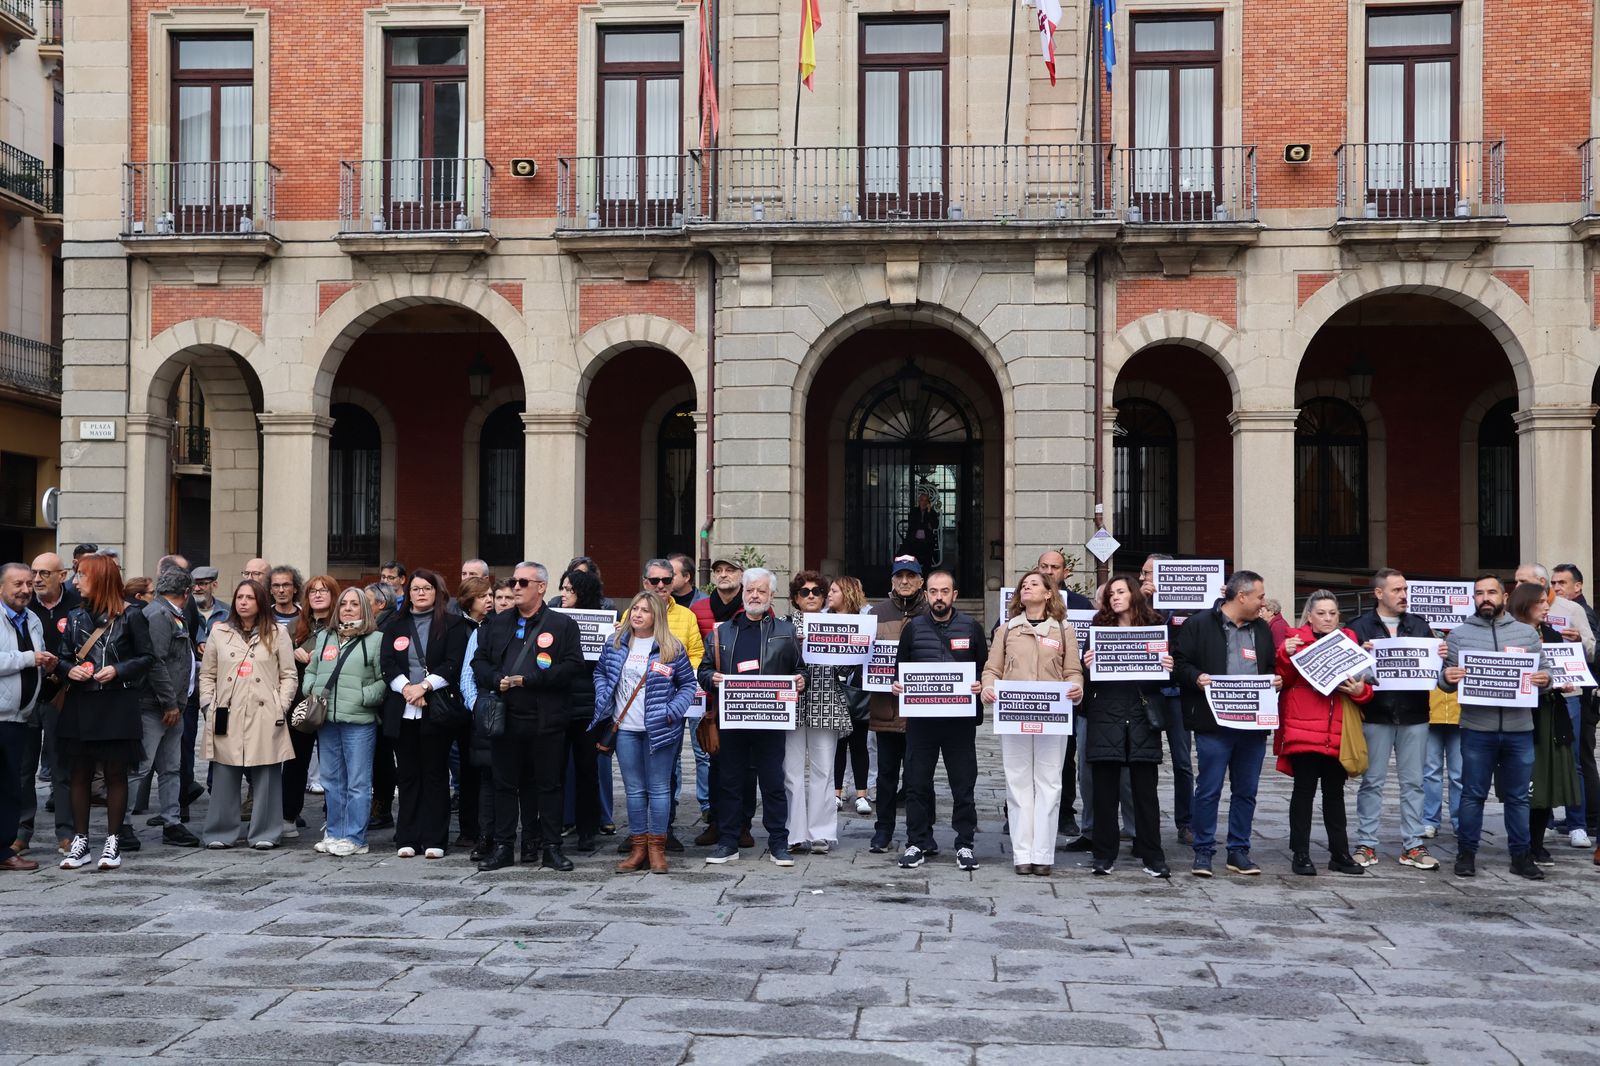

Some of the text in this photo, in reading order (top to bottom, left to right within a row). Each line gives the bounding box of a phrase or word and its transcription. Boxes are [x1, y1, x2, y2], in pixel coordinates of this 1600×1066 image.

[1412, 586, 1464, 595] Solidaridad
[1412, 604, 1451, 612] víctimas
[810, 624, 820, 632] Ni
[836, 625, 856, 633] solo
[810, 634, 846, 644] despido
[1096, 632, 1162, 640] Acompañamiento
[809, 646, 826, 654] por
[1103, 642, 1148, 650] reparación
[1378, 649, 1388, 657] Ni
[1406, 648, 1426, 656] solo
[1308, 646, 1342, 670] reparación
[1352, 654, 1366, 666] todo
[1466, 656, 1533, 666] Reconocimiento
[1378, 658, 1416, 668] despido
[1114, 664, 1144, 672] perdido
[1482, 668, 1508, 676] labor
[906, 674, 961, 682] Compromiso
[1312, 667, 1328, 680] para
[1378, 670, 1438, 680] por la DANA
[726, 680, 790, 689] Acompañamiento
[869, 676, 890, 684] de la
[1479, 680, 1518, 689] personas
[906, 684, 952, 692] político de
[732, 690, 776, 700] reparación
[1001, 691, 1058, 701] Compromiso
[1465, 688, 1514, 698] voluntarias
[906, 696, 970, 704] reconstrucción
[746, 702, 775, 710] quienes
[1000, 701, 1048, 711] político de
[1224, 703, 1257, 711] personas
[742, 713, 770, 722] perdido
[1000, 713, 1066, 722] reconstrucción
